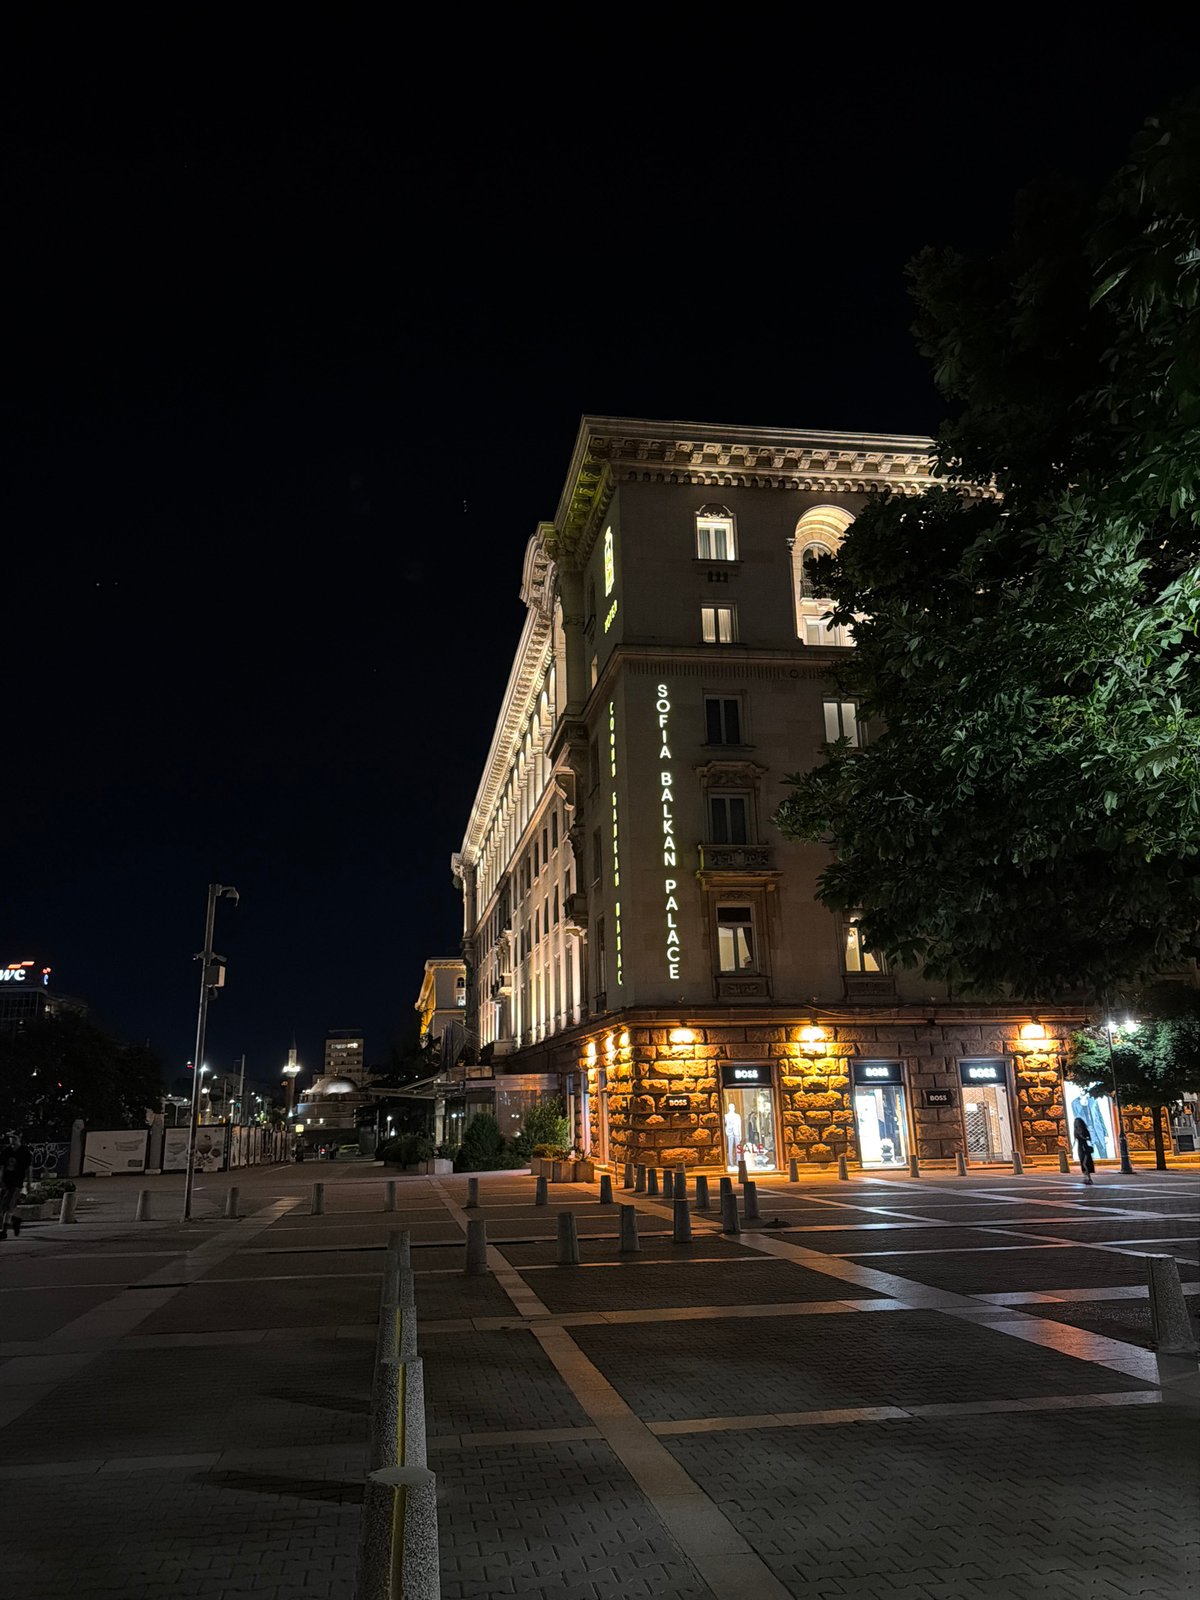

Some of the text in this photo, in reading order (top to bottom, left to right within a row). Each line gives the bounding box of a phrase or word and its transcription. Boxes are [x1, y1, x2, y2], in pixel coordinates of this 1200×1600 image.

[656, 683, 681, 980] SOFIA BALKAN PALACE
[734, 1069, 759, 1079] BOSS
[864, 1066, 890, 1077] BOSS
[968, 1066, 998, 1079] BOSS
[668, 1099, 688, 1107] BOSS
[736, 1143, 765, 1155] SALE
